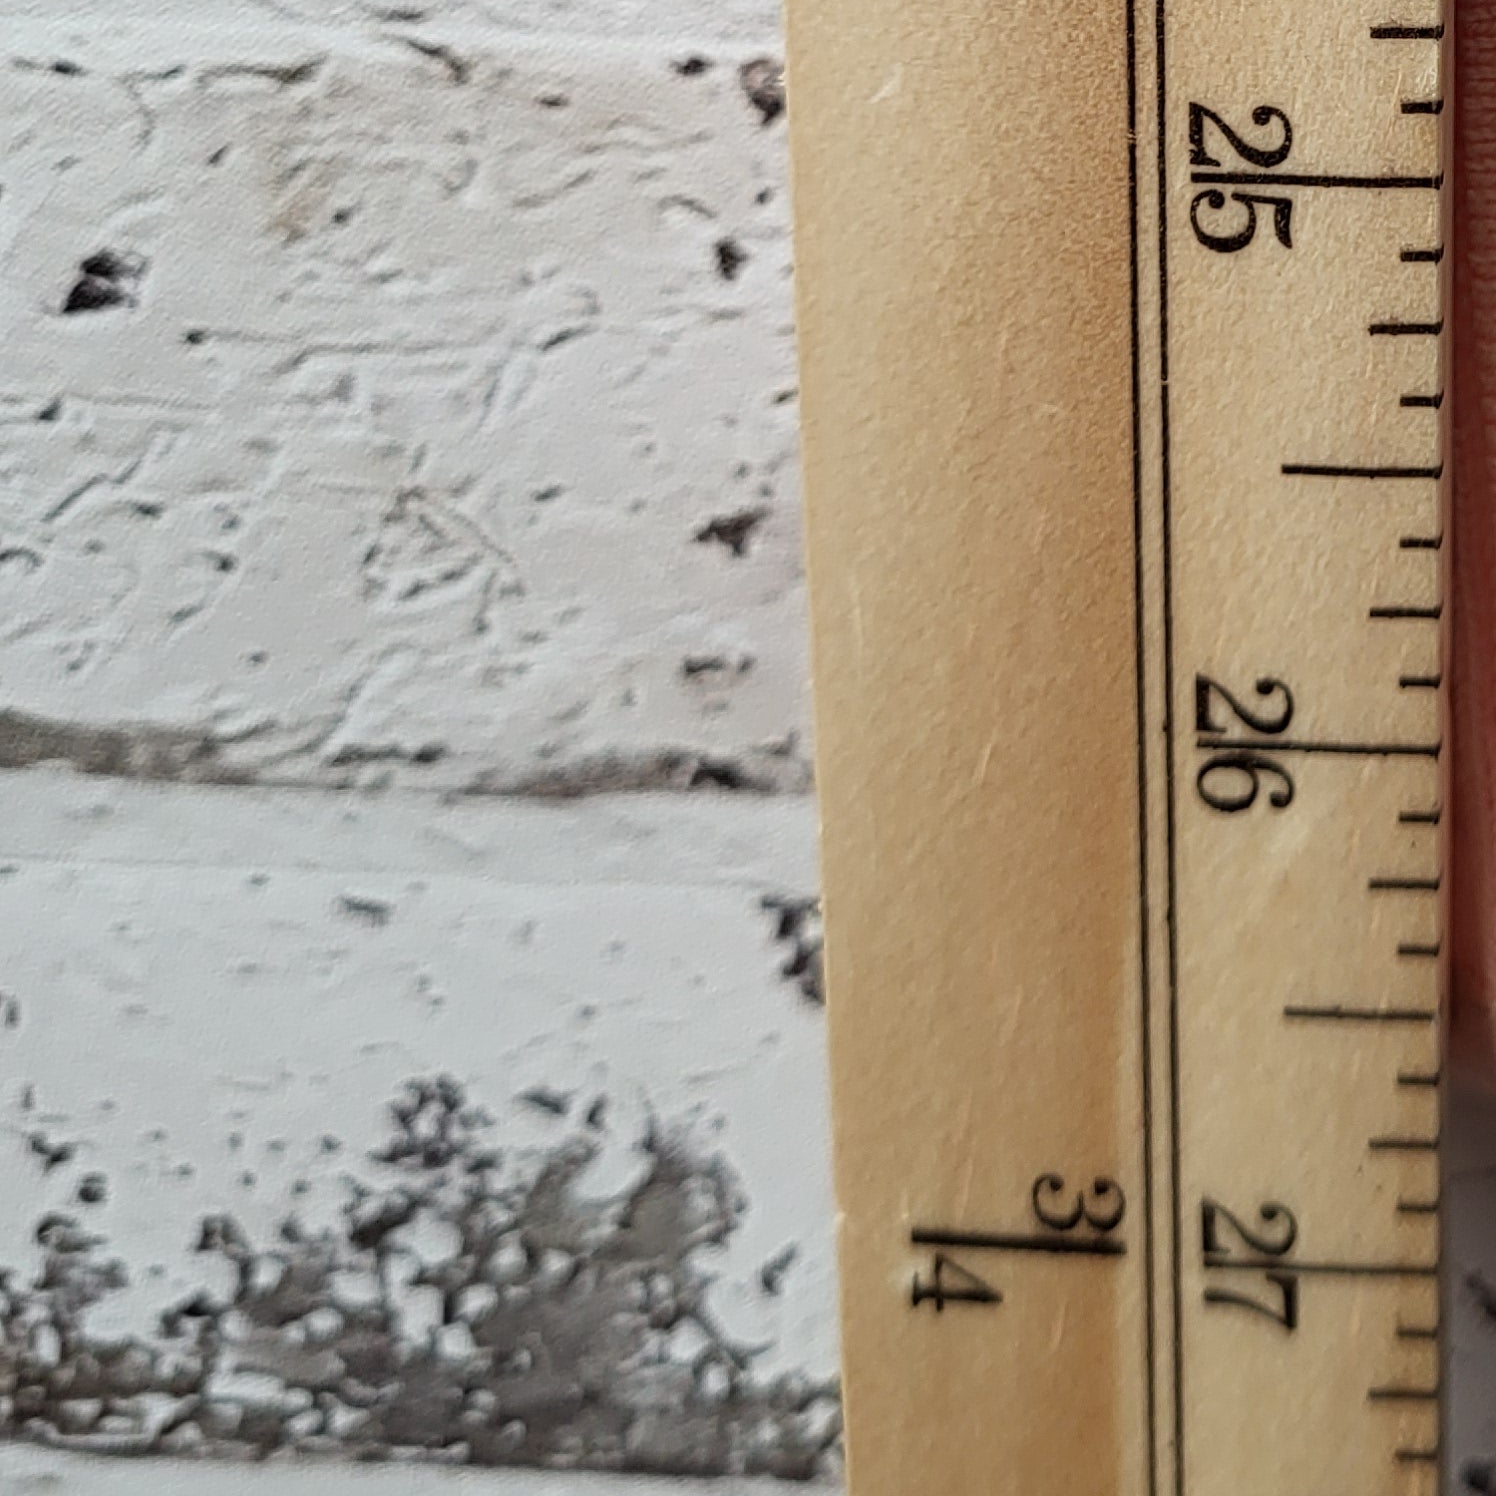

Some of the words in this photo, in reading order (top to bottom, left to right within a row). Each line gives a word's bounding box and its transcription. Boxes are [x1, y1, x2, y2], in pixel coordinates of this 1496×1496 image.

[1188, 101, 1295, 254] 25
[1194, 672, 1296, 814] 26
[1201, 1195, 1300, 1333] 27
